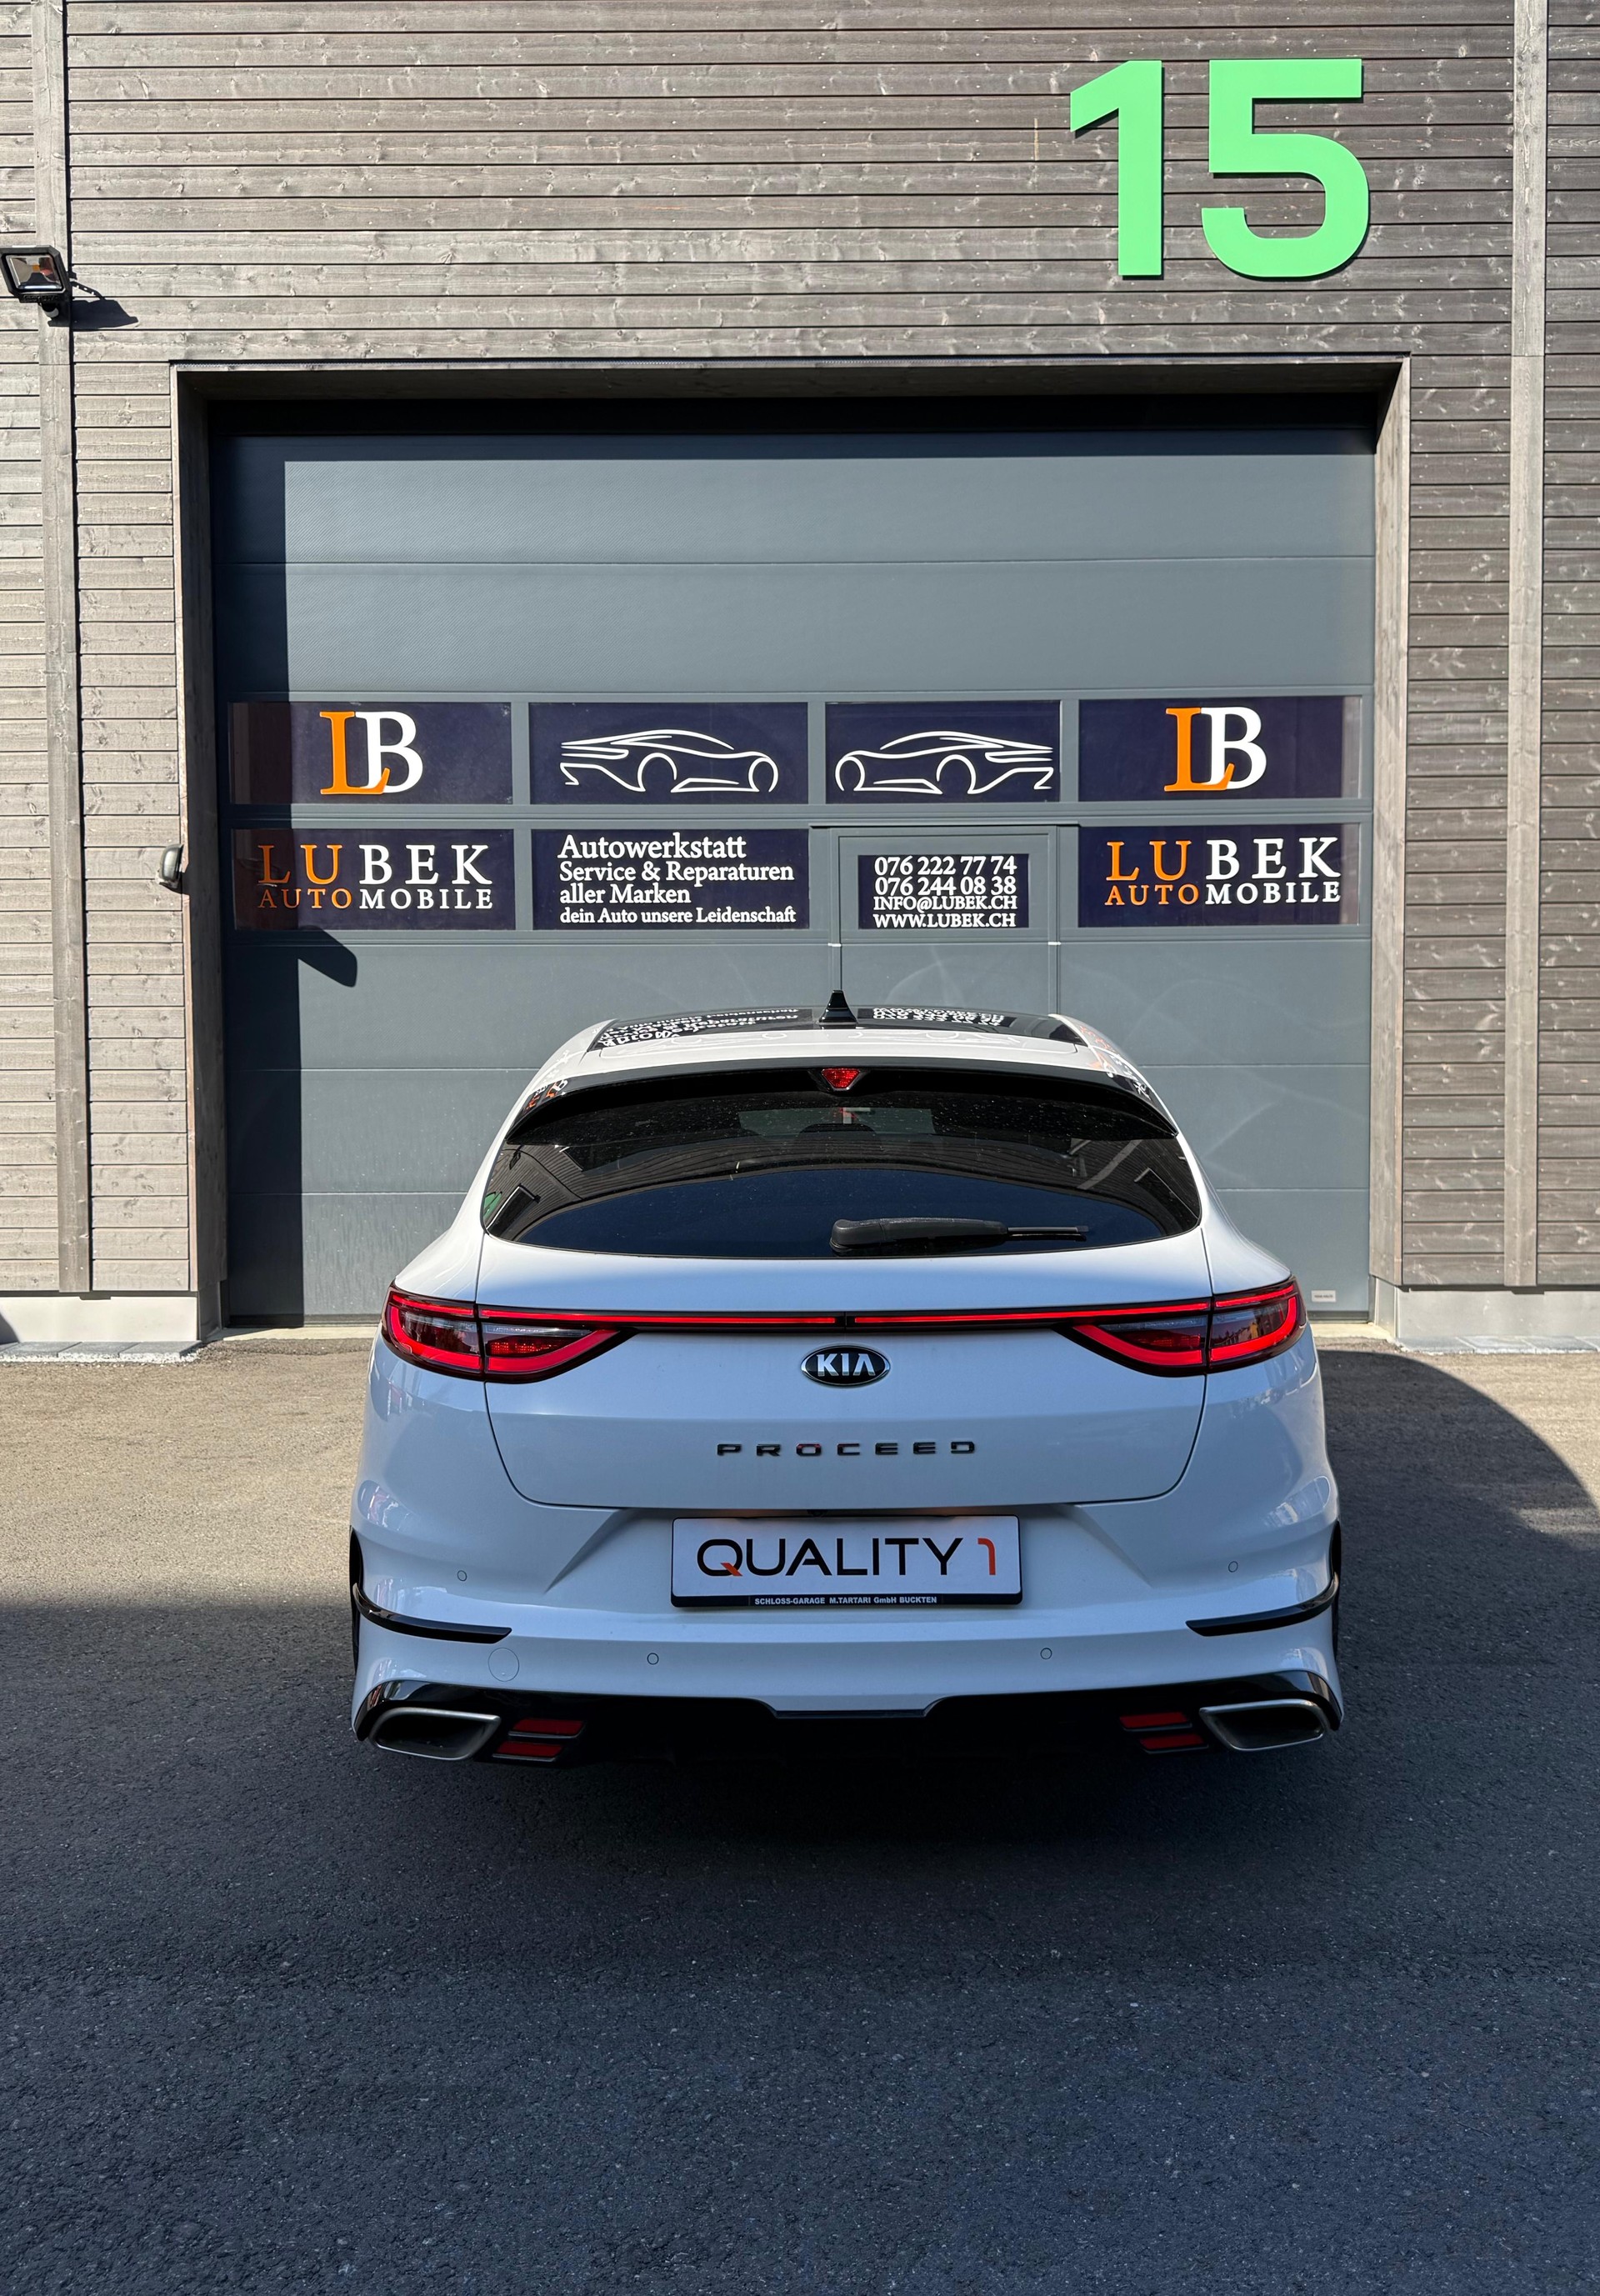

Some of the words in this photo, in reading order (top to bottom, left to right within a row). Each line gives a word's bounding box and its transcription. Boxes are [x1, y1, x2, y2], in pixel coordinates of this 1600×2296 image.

[1071, 59, 1368, 277] 15
[320, 711, 422, 795] LB
[1164, 707, 1266, 792] LB
[558, 832, 747, 858] Autowerkstatt
[258, 844, 492, 885] LUBEK
[874, 855, 913, 876] 076
[917, 855, 957, 875] 222
[960, 855, 987, 875] 77
[990, 855, 1018, 875] 74
[1106, 837, 1341, 880] LUBEK
[559, 860, 636, 881] Service
[641, 860, 661, 882] &
[665, 860, 795, 888] Reparaturen
[874, 876, 914, 896] 076
[917, 876, 958, 896] 244
[960, 876, 987, 896] 08
[990, 875, 1017, 896] 38
[258, 888, 493, 910] AUTOMOBILE
[559, 883, 607, 903] aller
[609, 882, 692, 903] Marken
[873, 895, 1018, 913] INFO@LUBEK.CH
[1104, 882, 1341, 906] AUTOMOBILE
[559, 907, 596, 923] dein
[597, 908, 638, 923] Auto
[640, 911, 693, 923] unsere
[695, 905, 797, 923] Leidenschaft
[872, 913, 1018, 928] WWW.LUBEK.CH
[816, 1353, 876, 1378] KIA
[717, 1441, 977, 1458] PROCEED
[697, 1538, 964, 1578] QUALITY
[754, 1597, 826, 1605] SCHLOSS-GARAGE
[873, 1596, 897, 1604] GmbH
[899, 1596, 938, 1604] BUCKTEN
